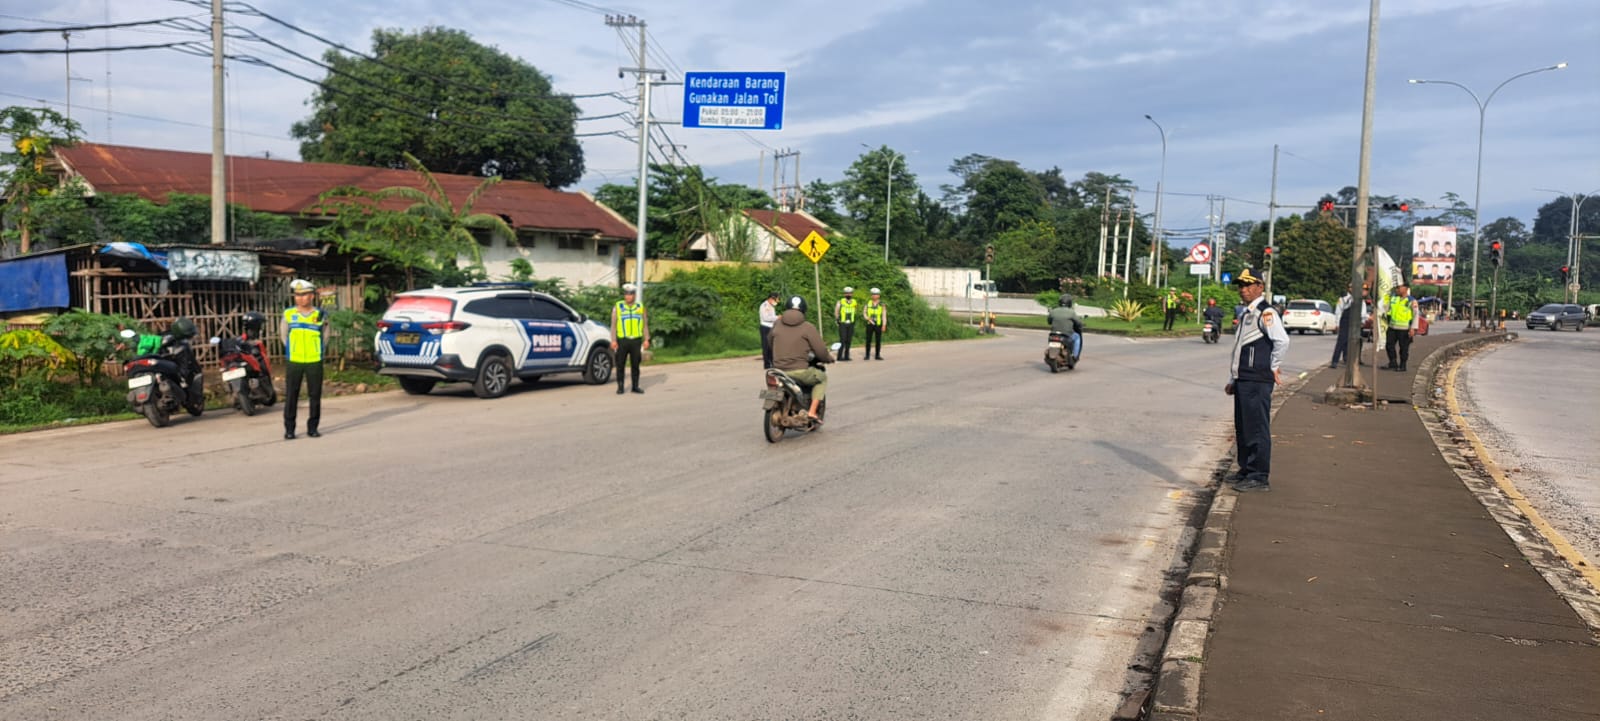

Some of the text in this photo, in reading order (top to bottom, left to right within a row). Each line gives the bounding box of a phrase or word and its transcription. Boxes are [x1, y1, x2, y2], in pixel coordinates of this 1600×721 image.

[689, 76, 780, 92] Kendaraan Barang
[689, 92, 779, 105] Gunakan Jalan Tol
[532, 334, 562, 347] POLISI
